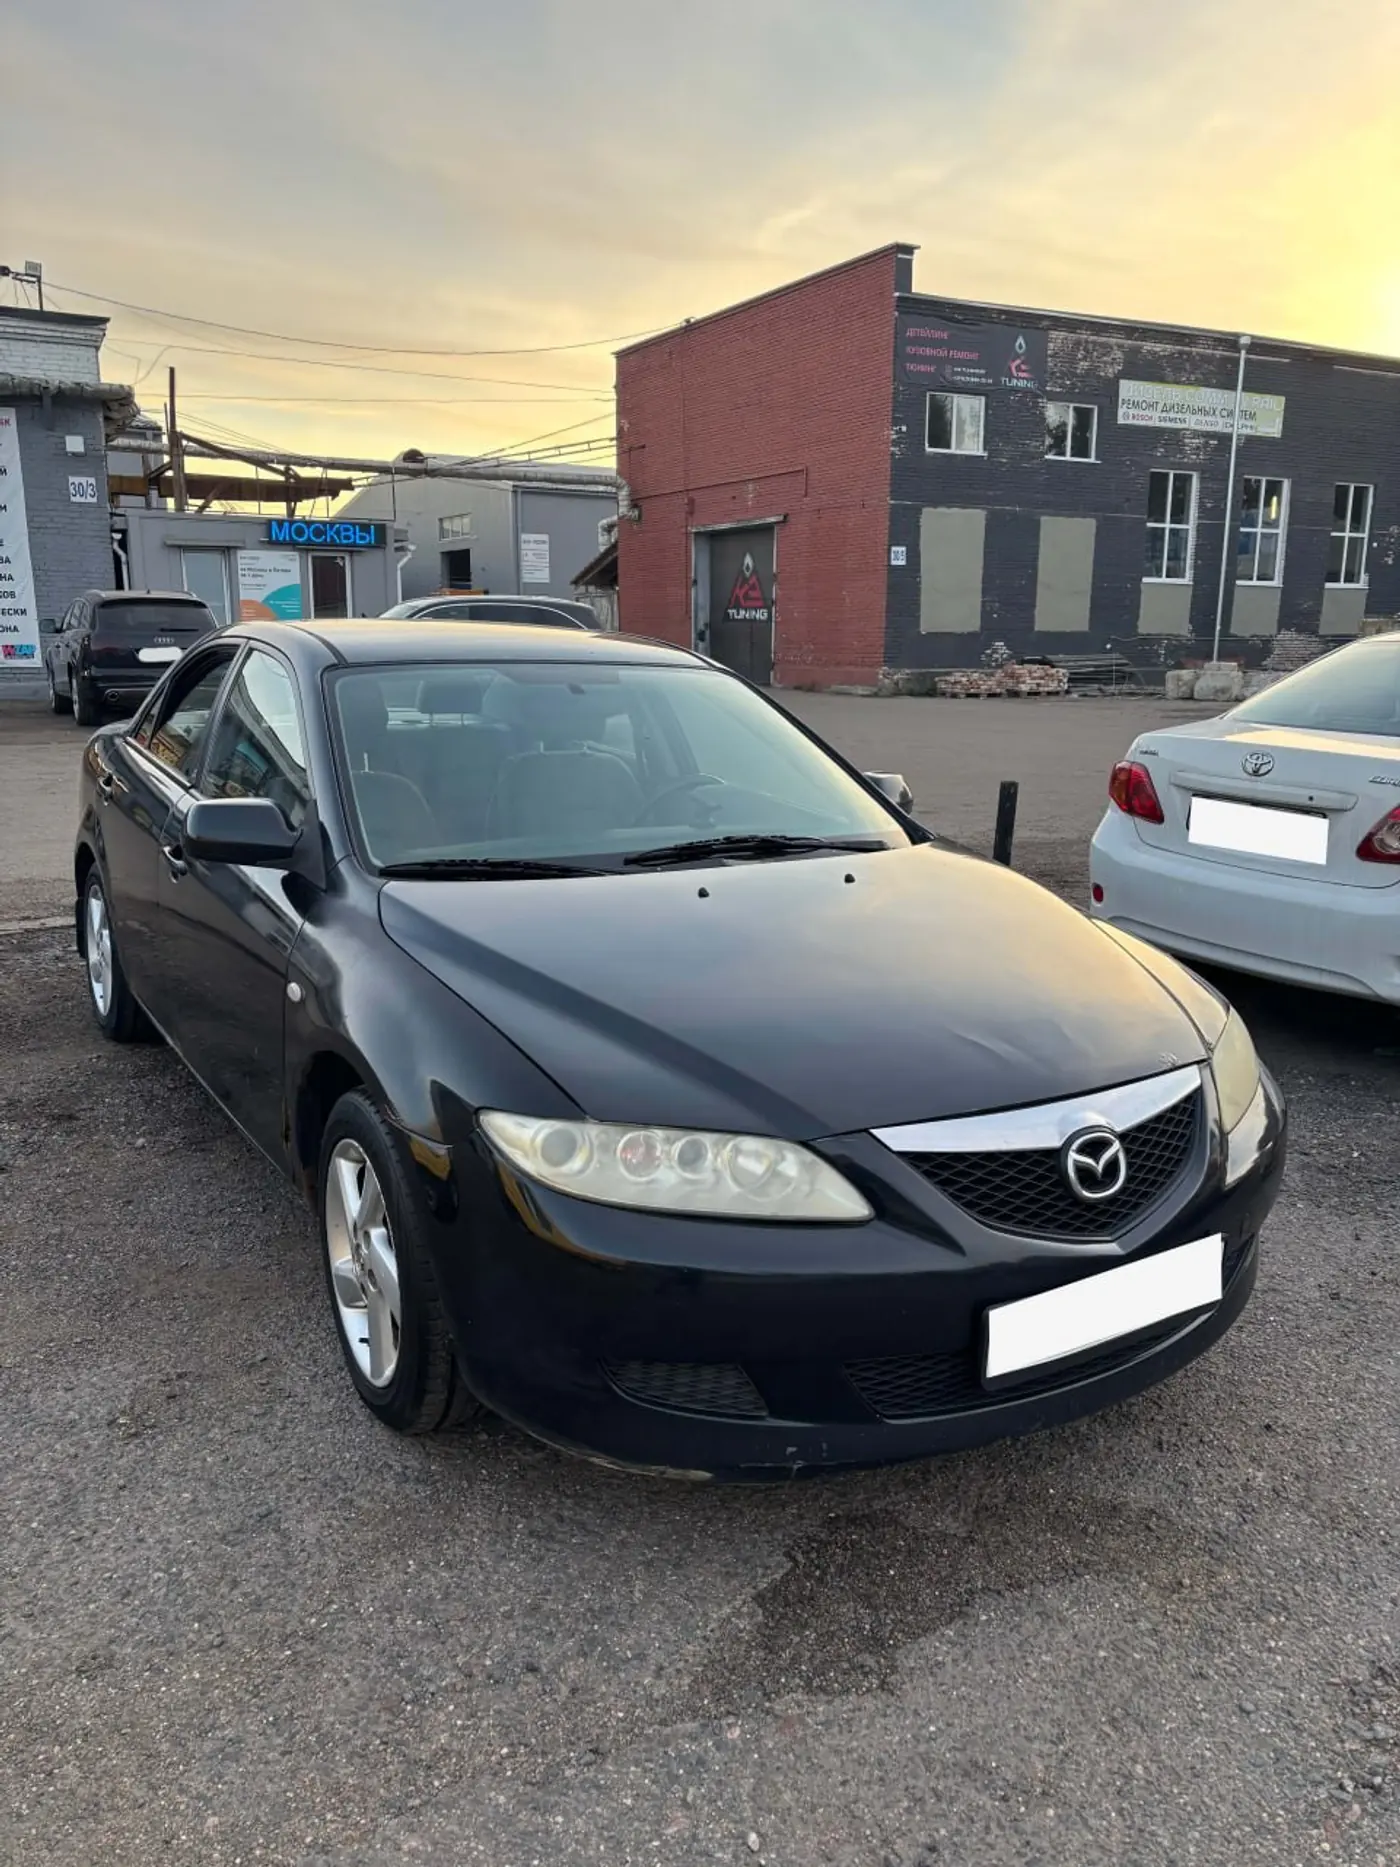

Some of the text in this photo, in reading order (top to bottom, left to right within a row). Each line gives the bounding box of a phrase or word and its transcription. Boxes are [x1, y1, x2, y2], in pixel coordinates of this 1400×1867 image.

[1120, 398, 1257, 422] РЕМОНТ ДИЗЕЛЬНЫХ СИТЕМ
[70, 480, 96, 499] 30/3
[271, 520, 375, 545] МОСКВЫ
[727, 608, 768, 621] TUNING
